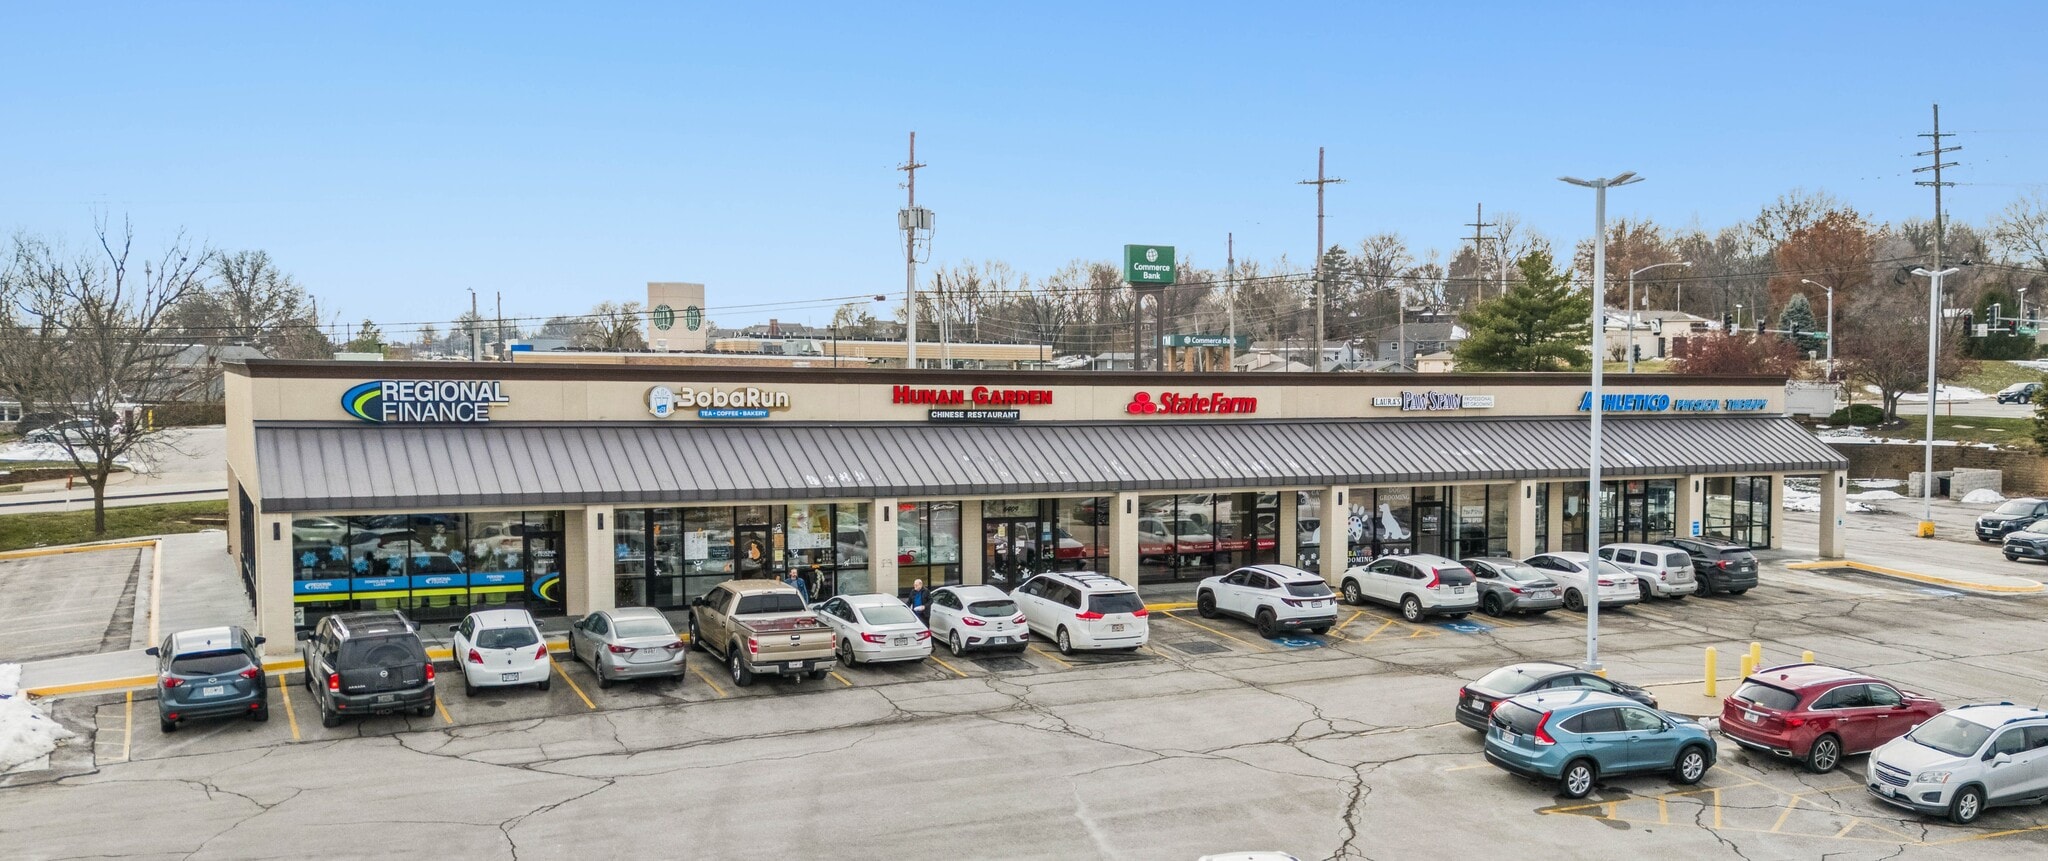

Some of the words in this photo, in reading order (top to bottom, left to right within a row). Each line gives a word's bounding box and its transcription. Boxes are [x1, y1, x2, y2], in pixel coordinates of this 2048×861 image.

[1134, 262, 1170, 272] Commerce
[1143, 271, 1161, 280] Bank
[1191, 336, 1221, 344] Commerce
[382, 381, 509, 402] REGIONAL
[893, 385, 964, 405] HUNAN
[972, 386, 1053, 405] GARDEN
[1375, 398, 1401, 406] LAURA'S
[1675, 399, 1720, 411] PHYSICAL
[1726, 399, 1768, 411] THERAPY
[382, 402, 490, 422] FINANCE
[931, 411, 964, 419] CHINESE
[967, 411, 1019, 419] RESTAURANT
